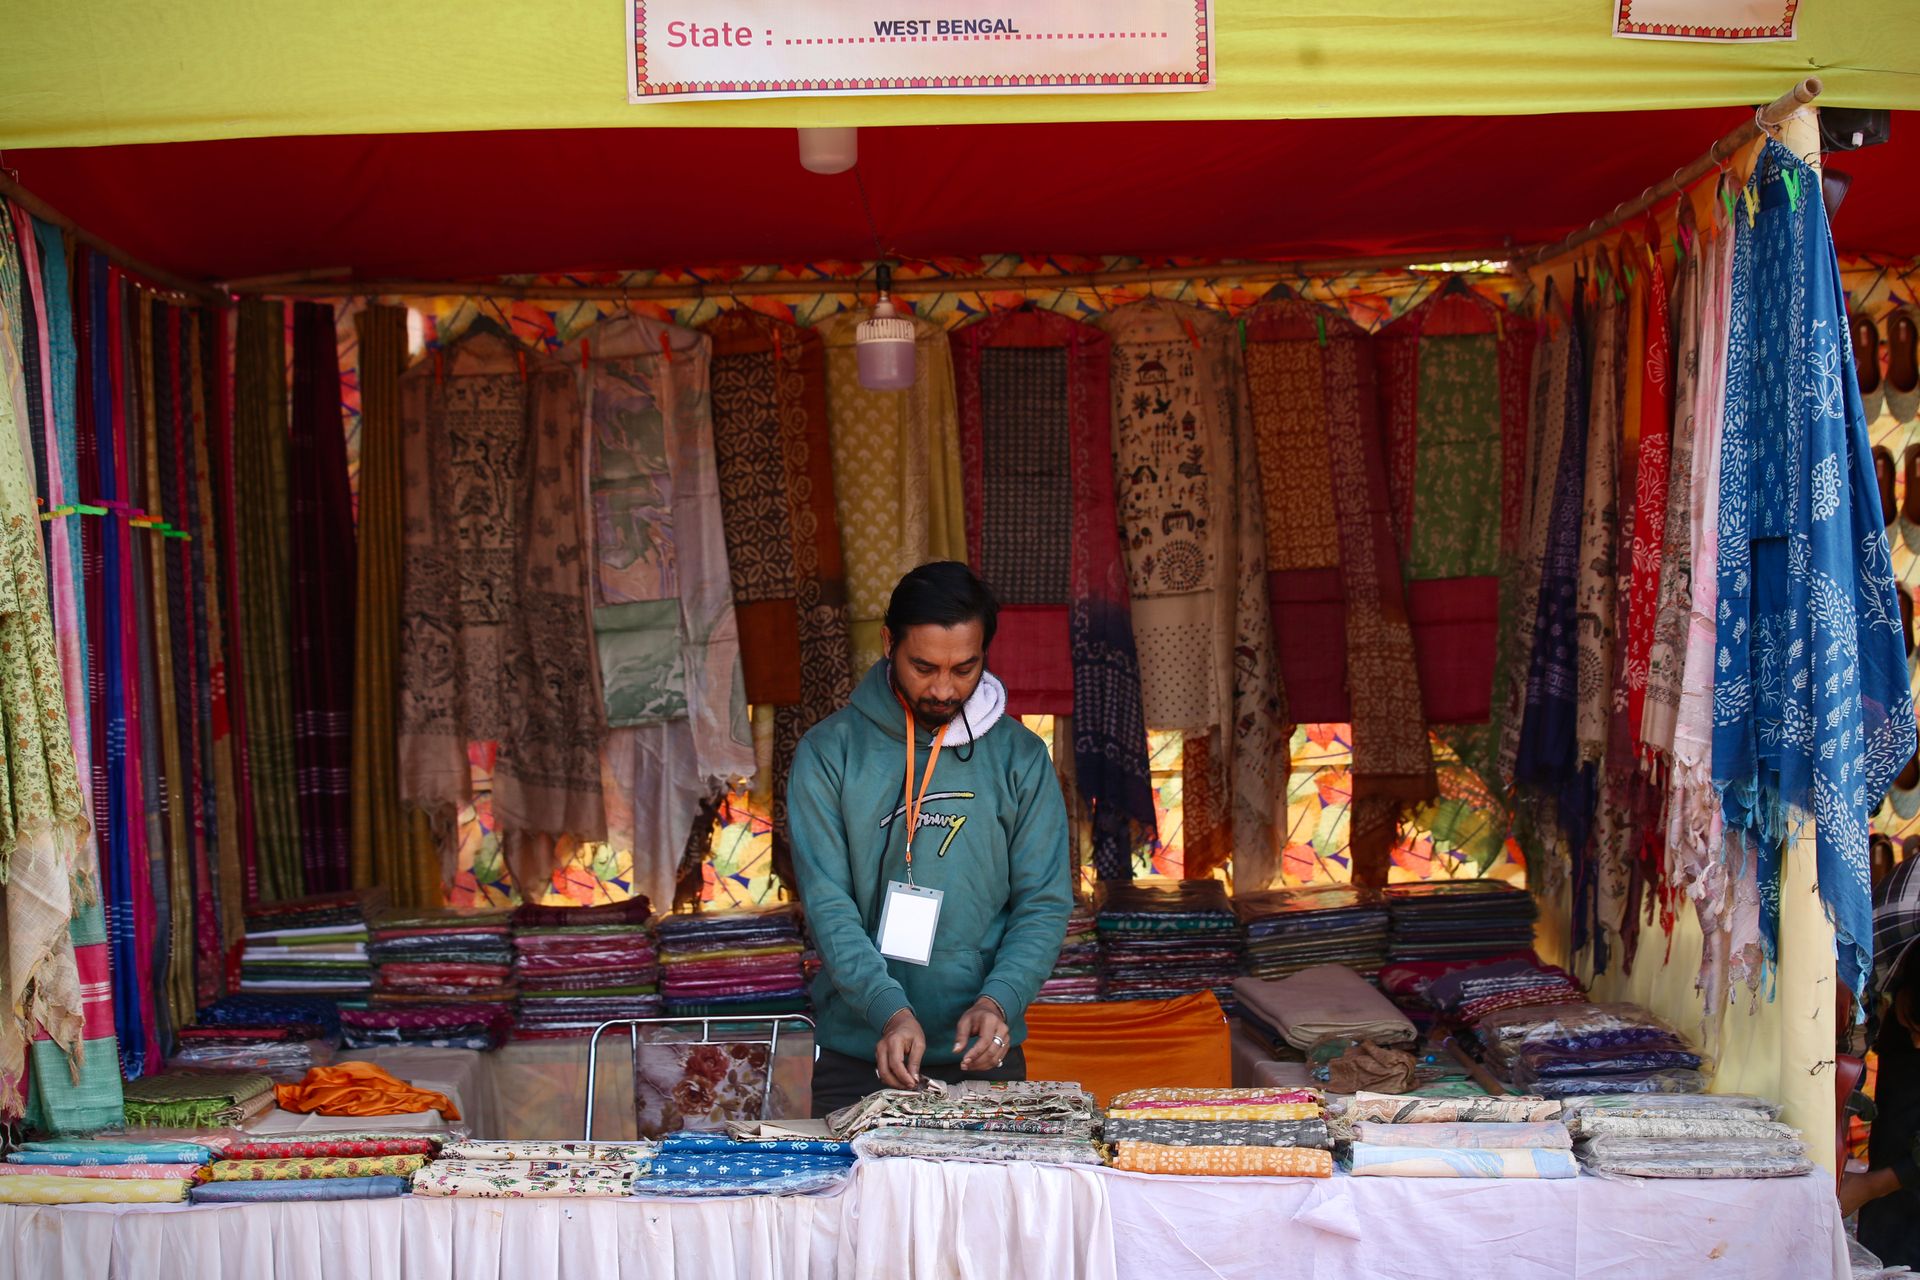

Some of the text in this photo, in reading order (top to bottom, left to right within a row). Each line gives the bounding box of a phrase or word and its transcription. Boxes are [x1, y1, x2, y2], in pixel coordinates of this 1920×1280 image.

[666, 20, 753, 48] State
[873, 19, 931, 36] WEST
[936, 18, 1020, 35] BENGAL
